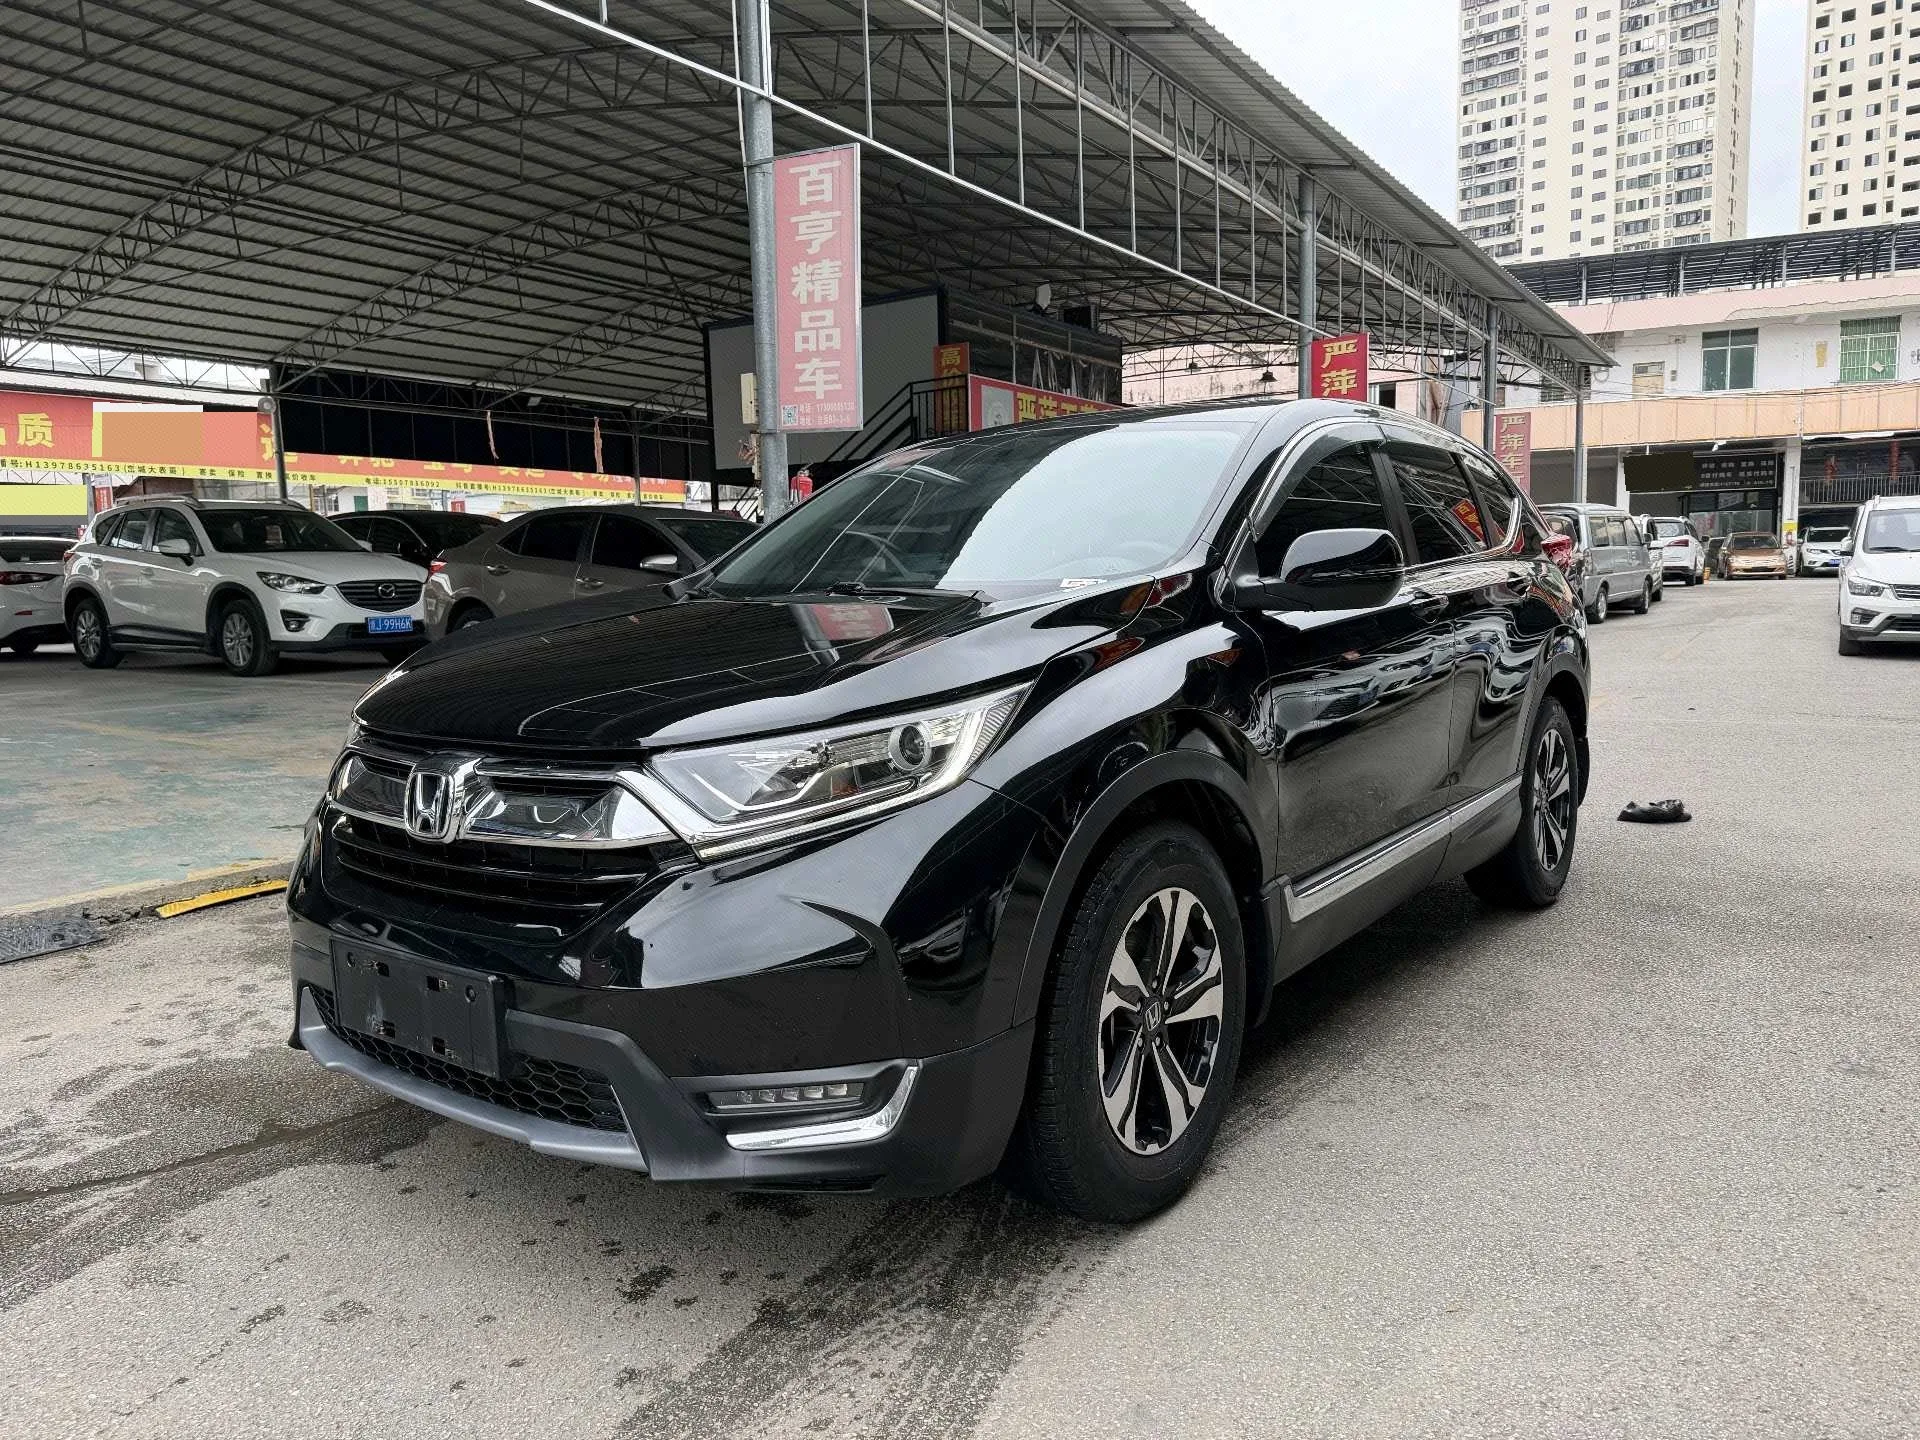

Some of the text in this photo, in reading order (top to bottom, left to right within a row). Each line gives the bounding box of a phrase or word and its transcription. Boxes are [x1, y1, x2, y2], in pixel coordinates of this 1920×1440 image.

[789, 160, 842, 400] 百亨精品车
[1320, 339, 1358, 397] 严萍
[0, 412, 55, 448] 质
